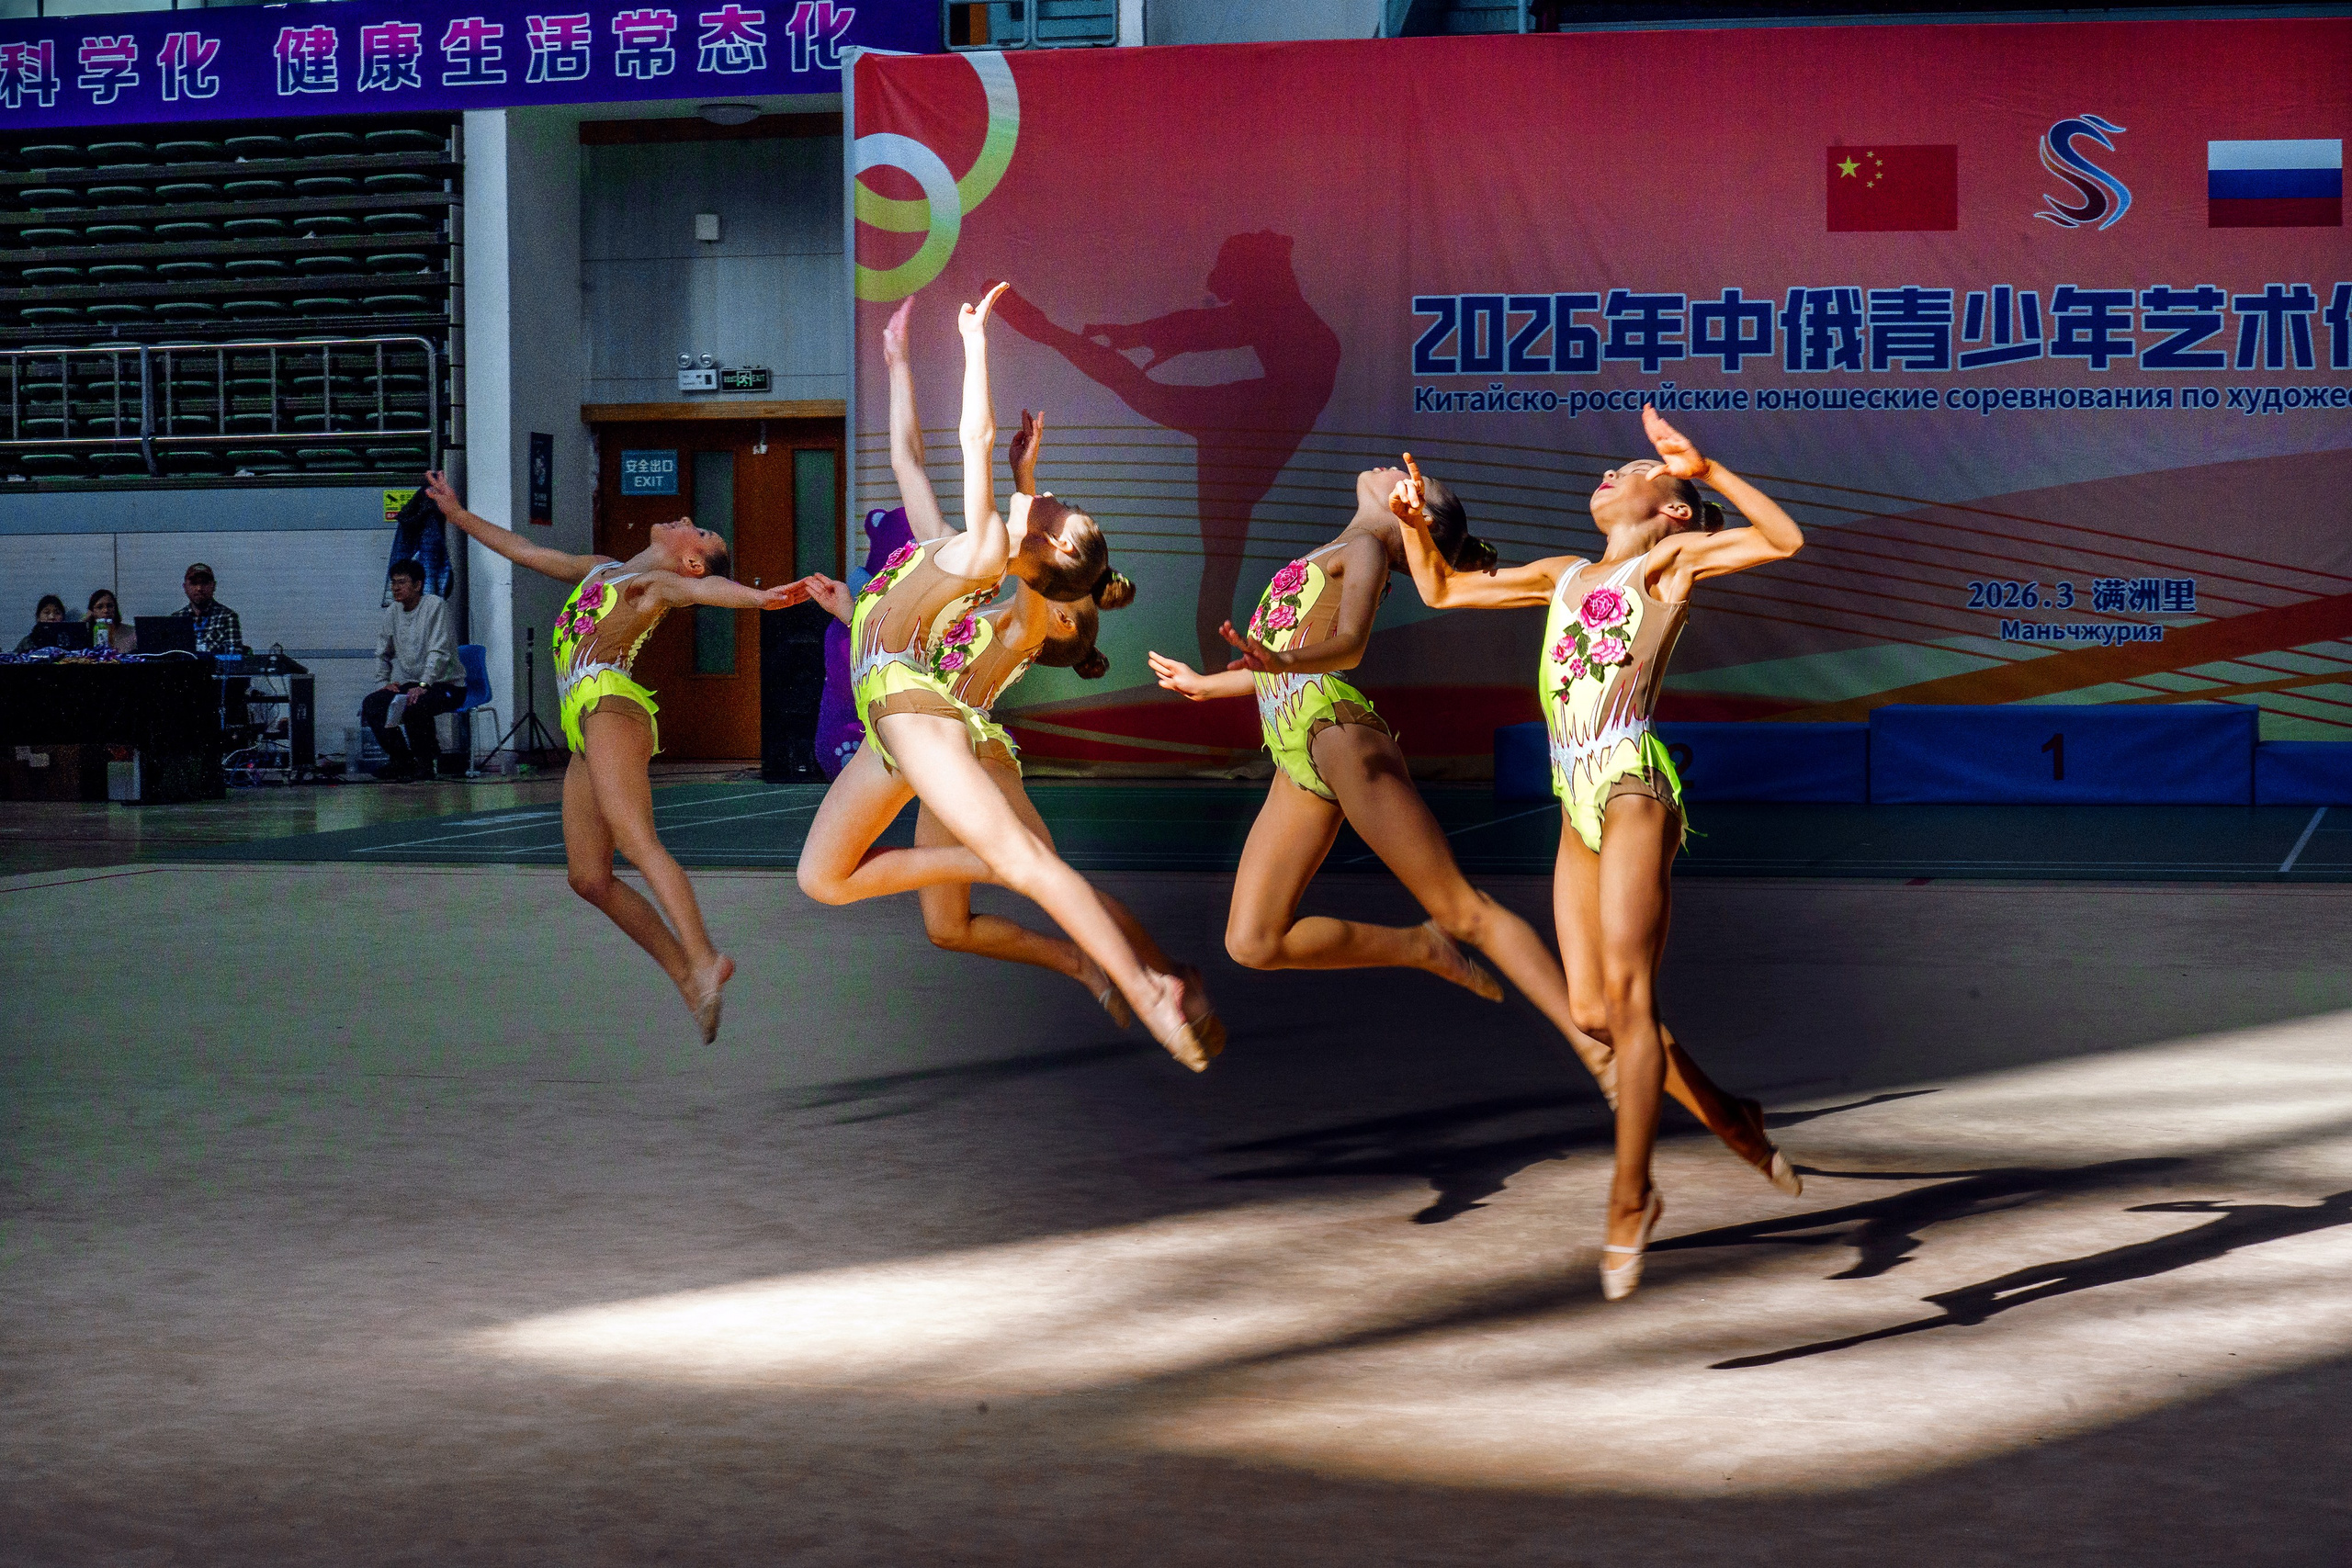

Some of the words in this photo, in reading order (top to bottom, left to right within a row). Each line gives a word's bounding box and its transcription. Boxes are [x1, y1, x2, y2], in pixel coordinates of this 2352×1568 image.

[0, 31, 220, 108] 科学化
[274, 1, 854, 96] 健康生活常态化
[1414, 383, 1747, 418] Китайско-российские
[1756, 387, 1938, 411] юношеские
[1946, 387, 2172, 415] соревнования
[2181, 387, 2219, 410] по
[2227, 387, 2352, 415] художе
[625, 458, 673, 473] 安全出口
[635, 476, 664, 487] EXIT
[1967, 581, 2075, 609] 2026.3
[2092, 578, 2197, 613] 满洲里
[1999, 619, 2164, 647] Маньчжурия
[2041, 733, 2064, 780] 1
